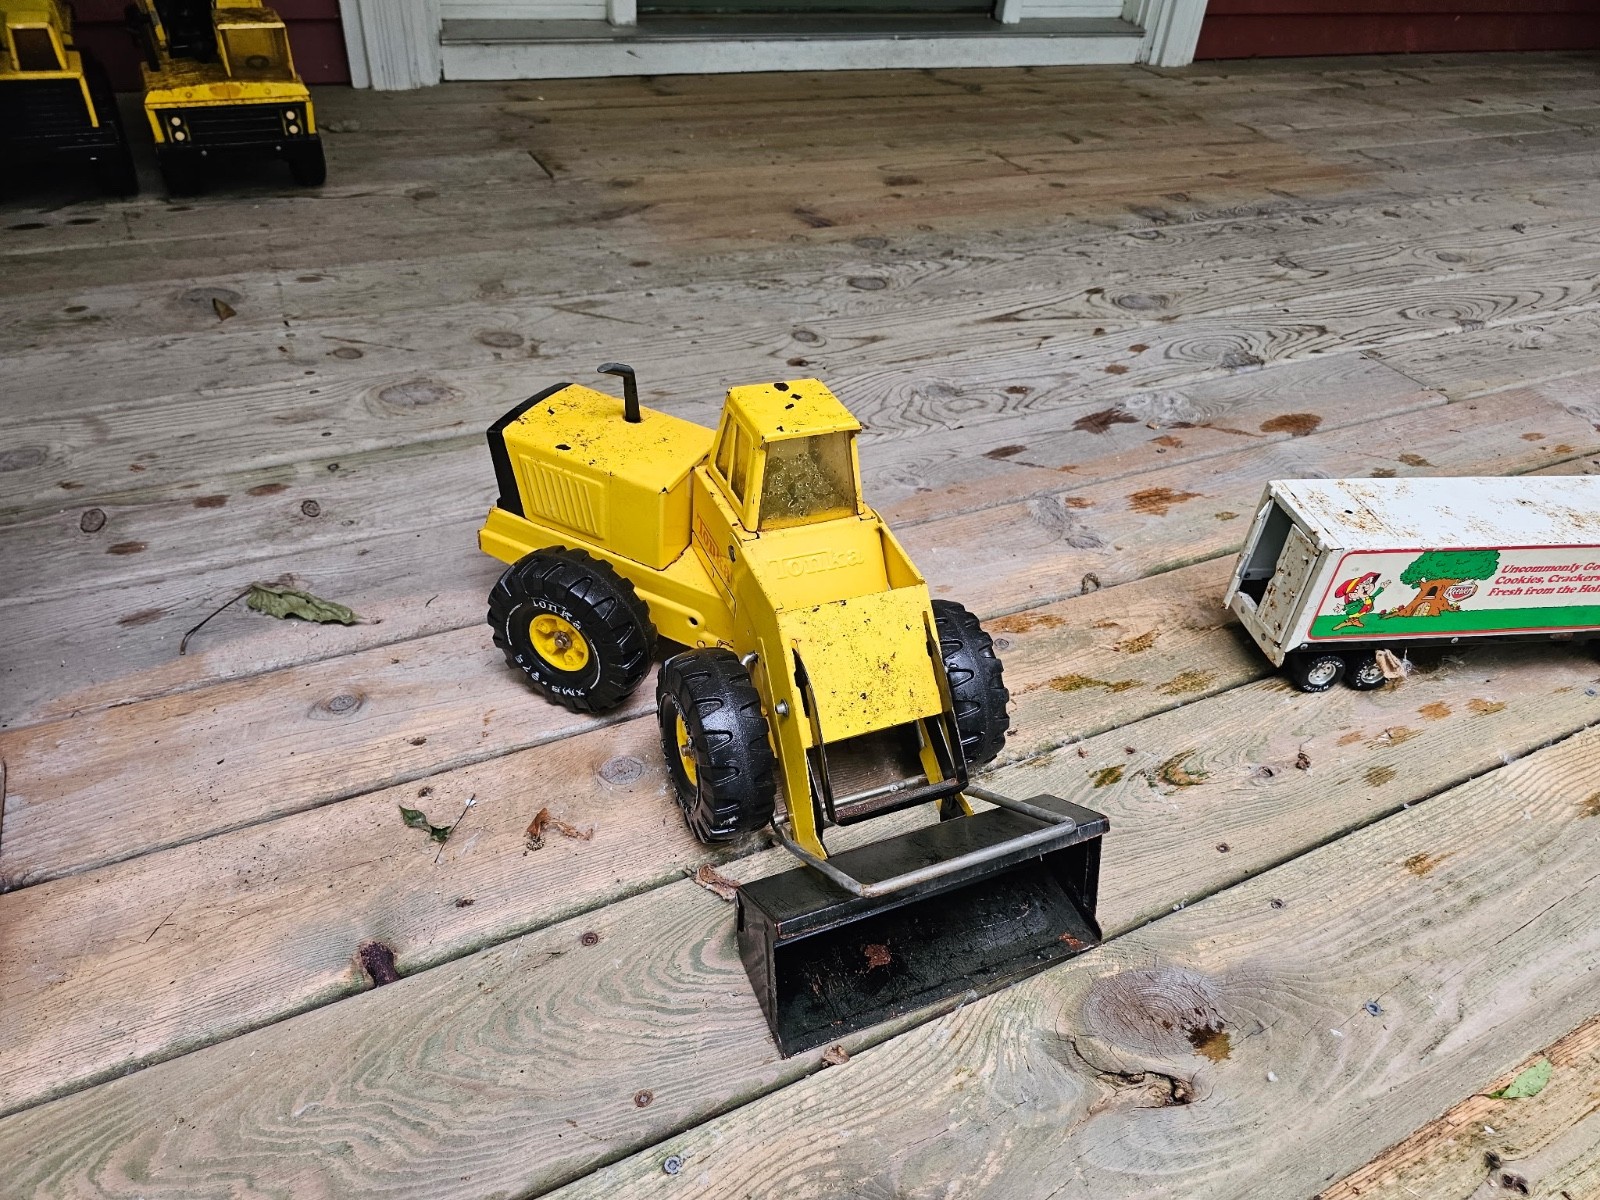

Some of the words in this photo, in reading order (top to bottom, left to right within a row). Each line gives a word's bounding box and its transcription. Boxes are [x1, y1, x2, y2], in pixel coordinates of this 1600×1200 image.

[767, 549, 865, 580] Tonka
[1501, 562, 1582, 574] Uncommonly
[1494, 575, 1544, 585] Cookies,
[1487, 587, 1523, 597] Fresh
[1524, 586, 1555, 596] from
[1556, 584, 1577, 594] the
[1577, 584, 1600, 593] Hol
[531, 597, 582, 630] Tonka
